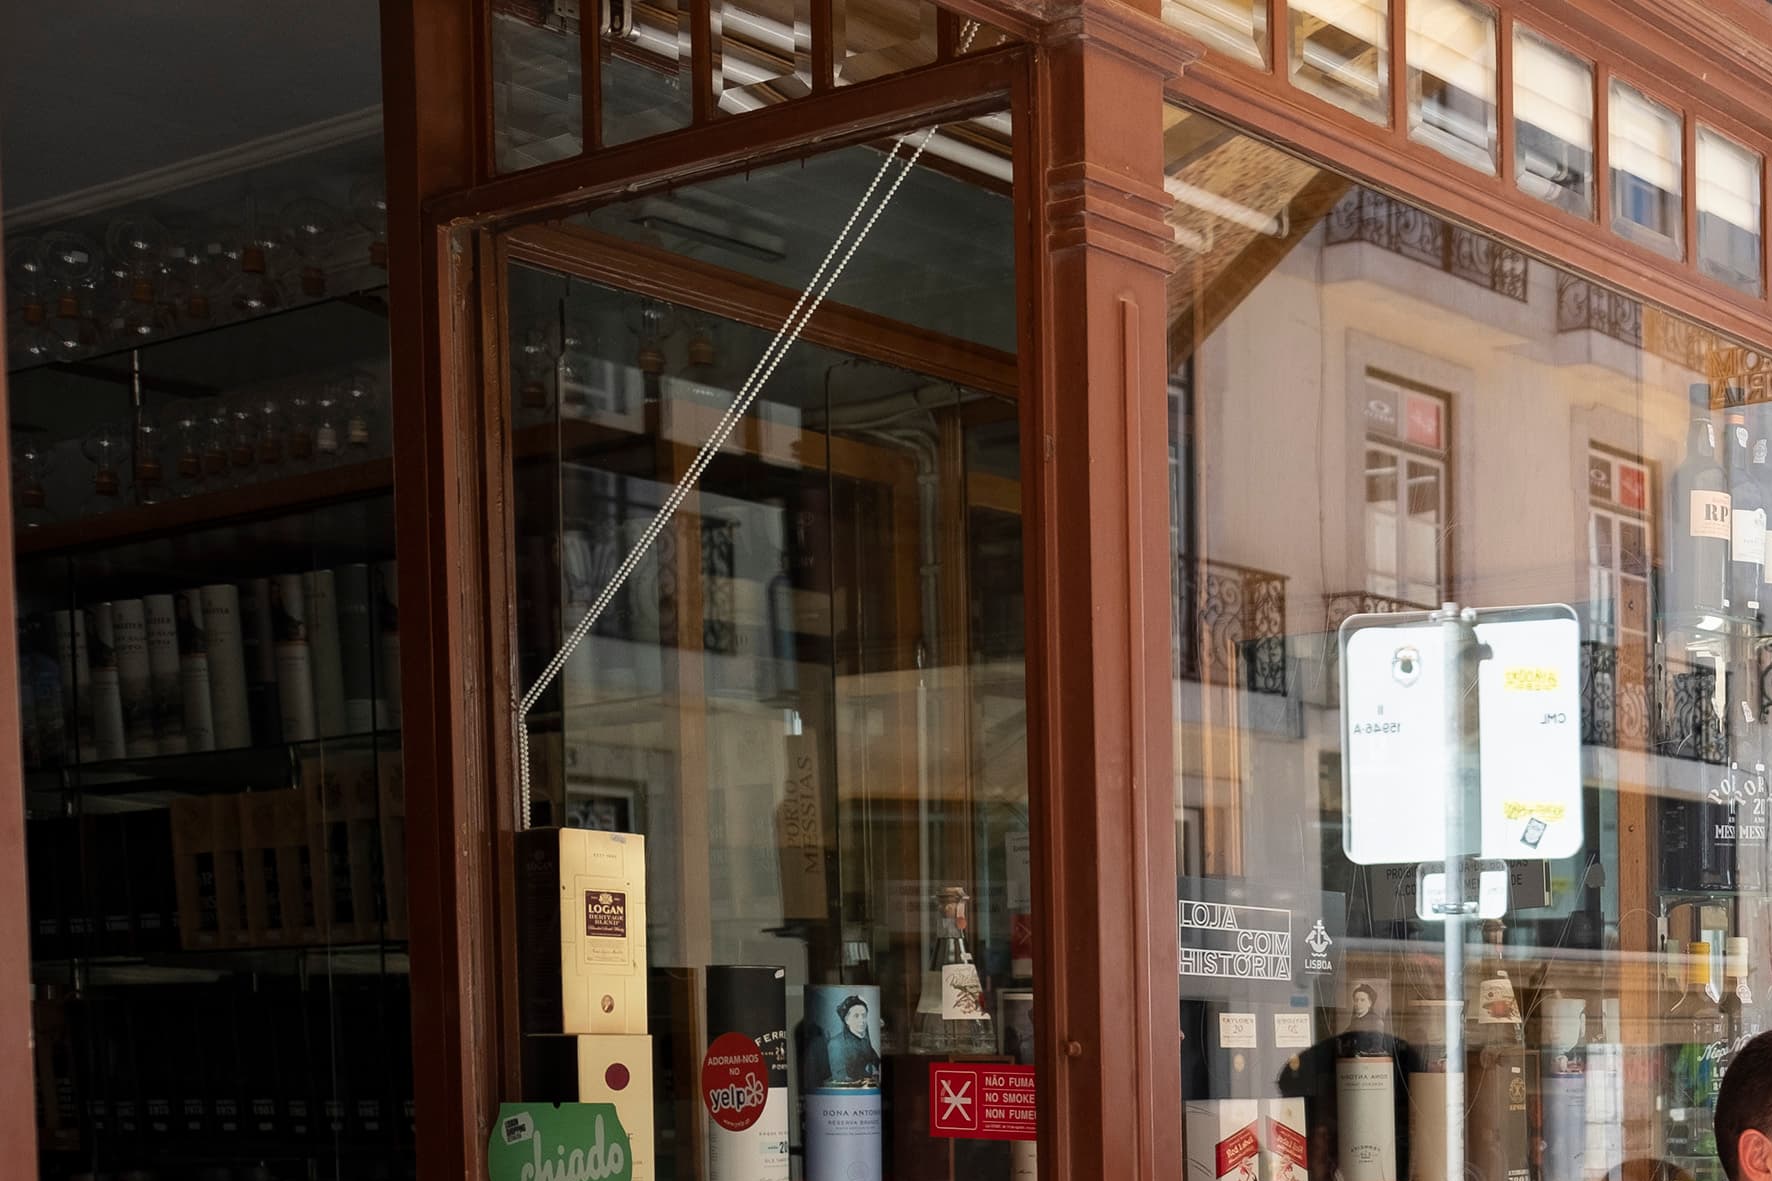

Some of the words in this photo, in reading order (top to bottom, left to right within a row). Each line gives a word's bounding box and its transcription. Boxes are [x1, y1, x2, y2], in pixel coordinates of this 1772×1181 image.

[588, 903, 624, 915] LOGAN
[1181, 902, 1239, 929] LOJA
[1237, 930, 1290, 956] COM
[1180, 949, 1290, 978] HISTÓRIA
[1304, 958, 1333, 971] LISBOA
[707, 1053, 760, 1066] ADORAM-NOS
[729, 1067, 741, 1077] NO
[985, 1074, 1006, 1087] NÃO
[709, 1083, 747, 1114] yelp
[985, 1092, 999, 1103] NO
[1002, 1093, 1035, 1104] SMOKE
[985, 1108, 1006, 1119] NON
[1009, 1109, 1036, 1120] FUME
